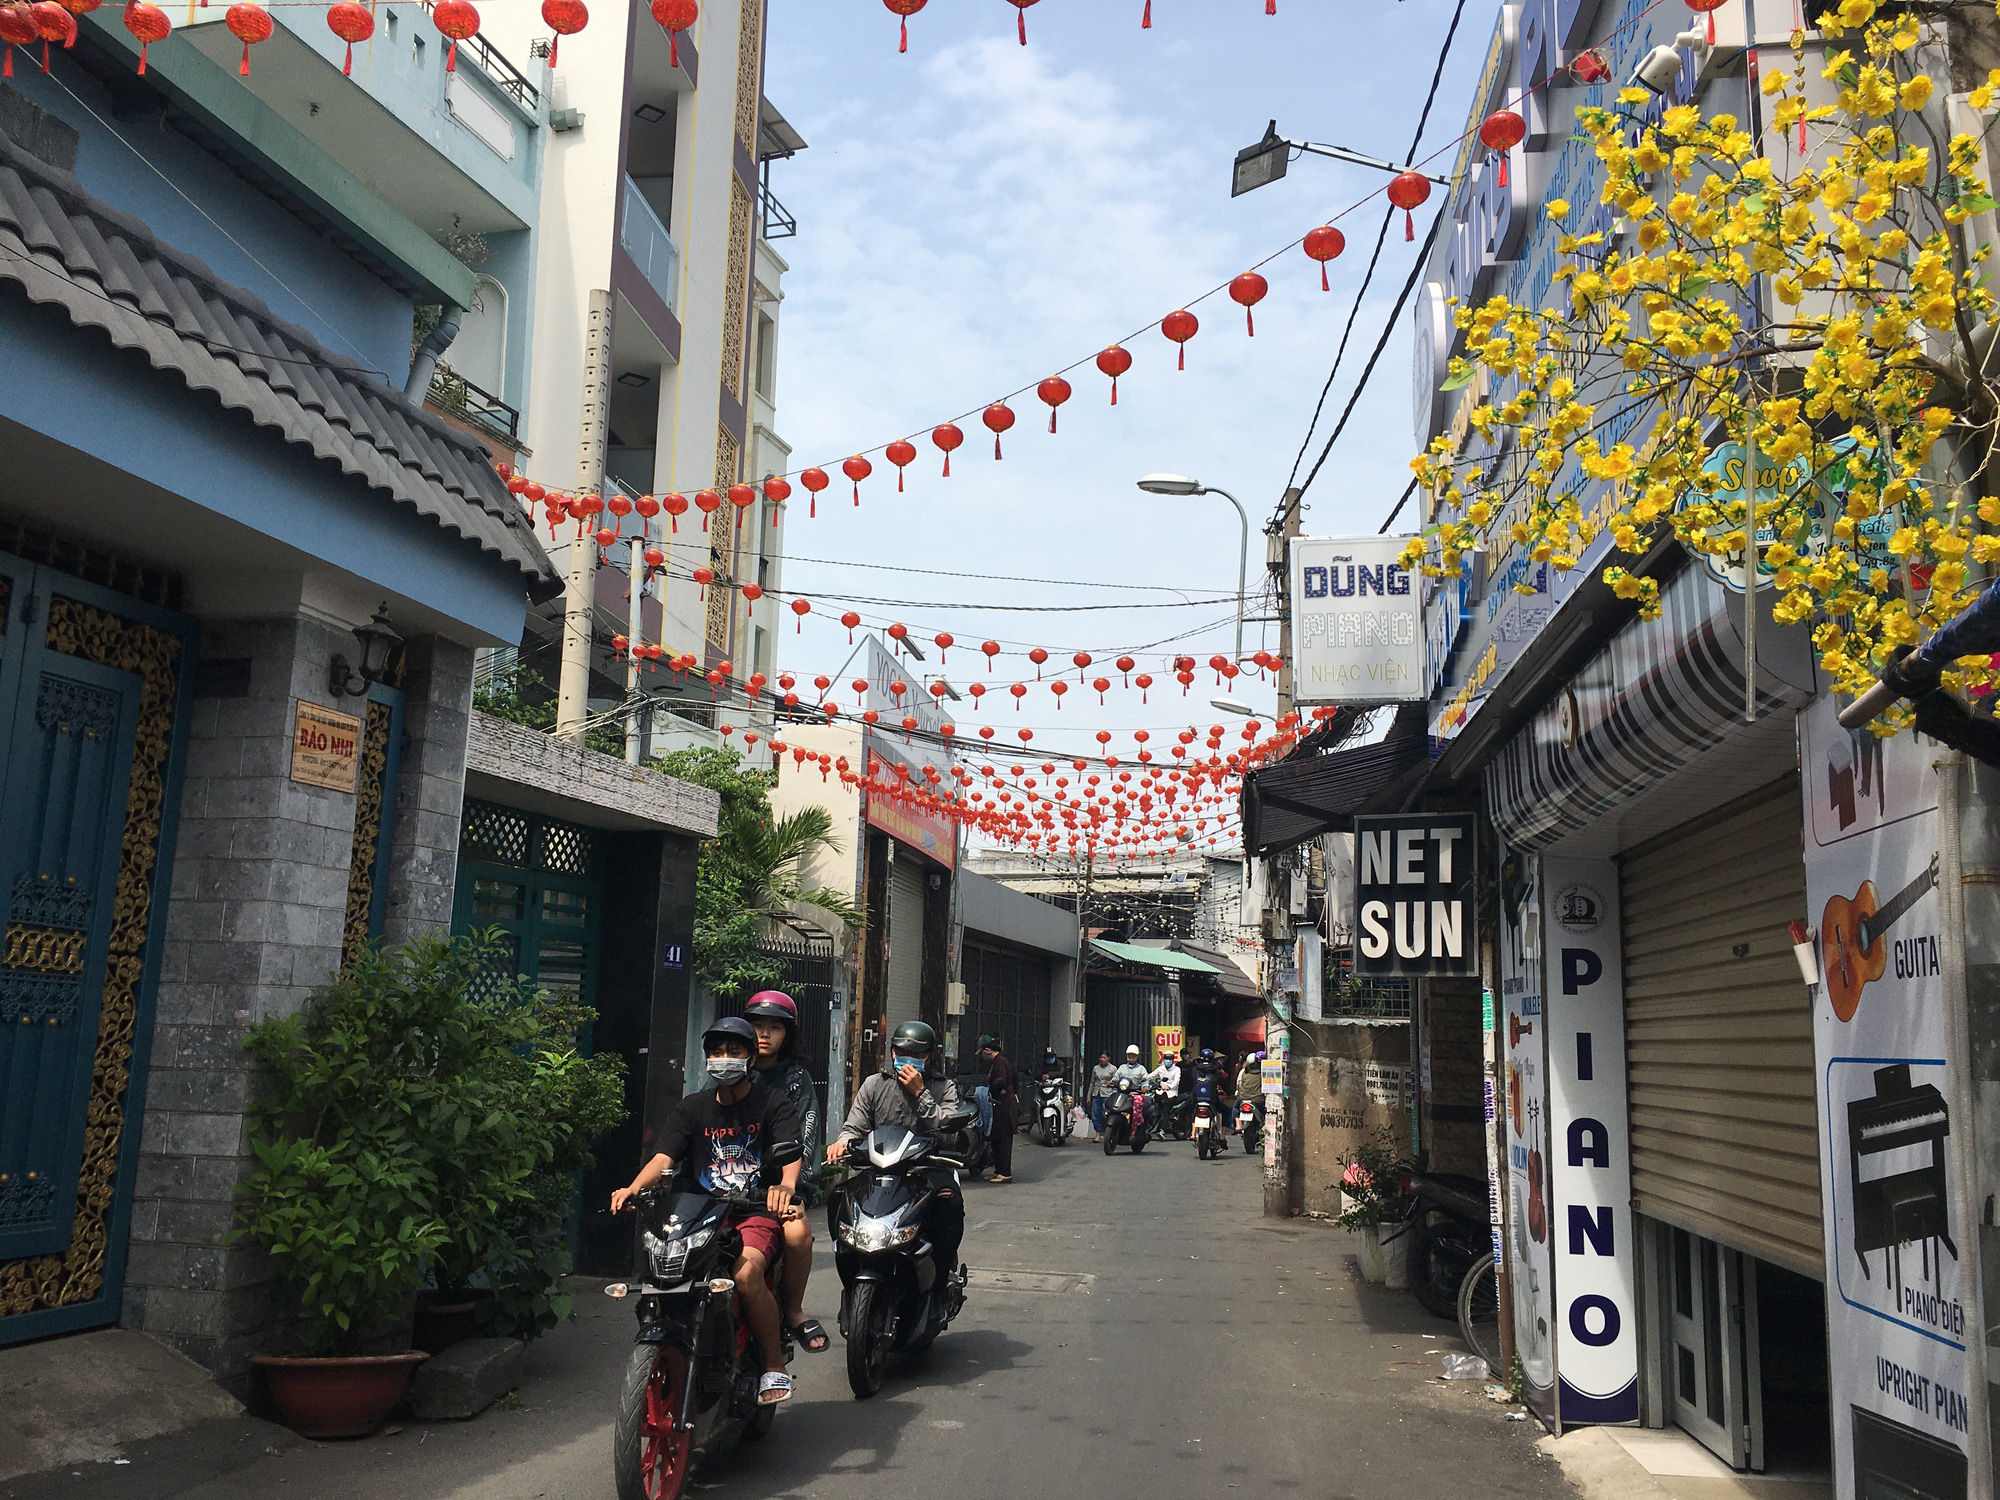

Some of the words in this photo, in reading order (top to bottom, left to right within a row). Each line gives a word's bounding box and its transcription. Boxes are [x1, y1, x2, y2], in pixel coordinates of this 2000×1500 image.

[1303, 555, 1411, 599] DŨNG
[1302, 610, 1415, 649] PIANO
[1311, 663, 1361, 686] NHẠC
[1366, 657, 1409, 685] VIỆN
[300, 725, 327, 751] BẢO
[331, 736, 354, 758] NHI
[1361, 827, 1462, 885] NET
[1360, 900, 1463, 959] SUN
[666, 946, 680, 961] 41
[1894, 934, 1941, 980] GUITA
[833, 993, 840, 1002] 43
[1155, 1029, 1183, 1047] GIỮ
[1561, 946, 1622, 1348] PIANO
[1905, 1287, 1938, 1326] PIANO
[1877, 1355, 1930, 1415] UPRIGHT
